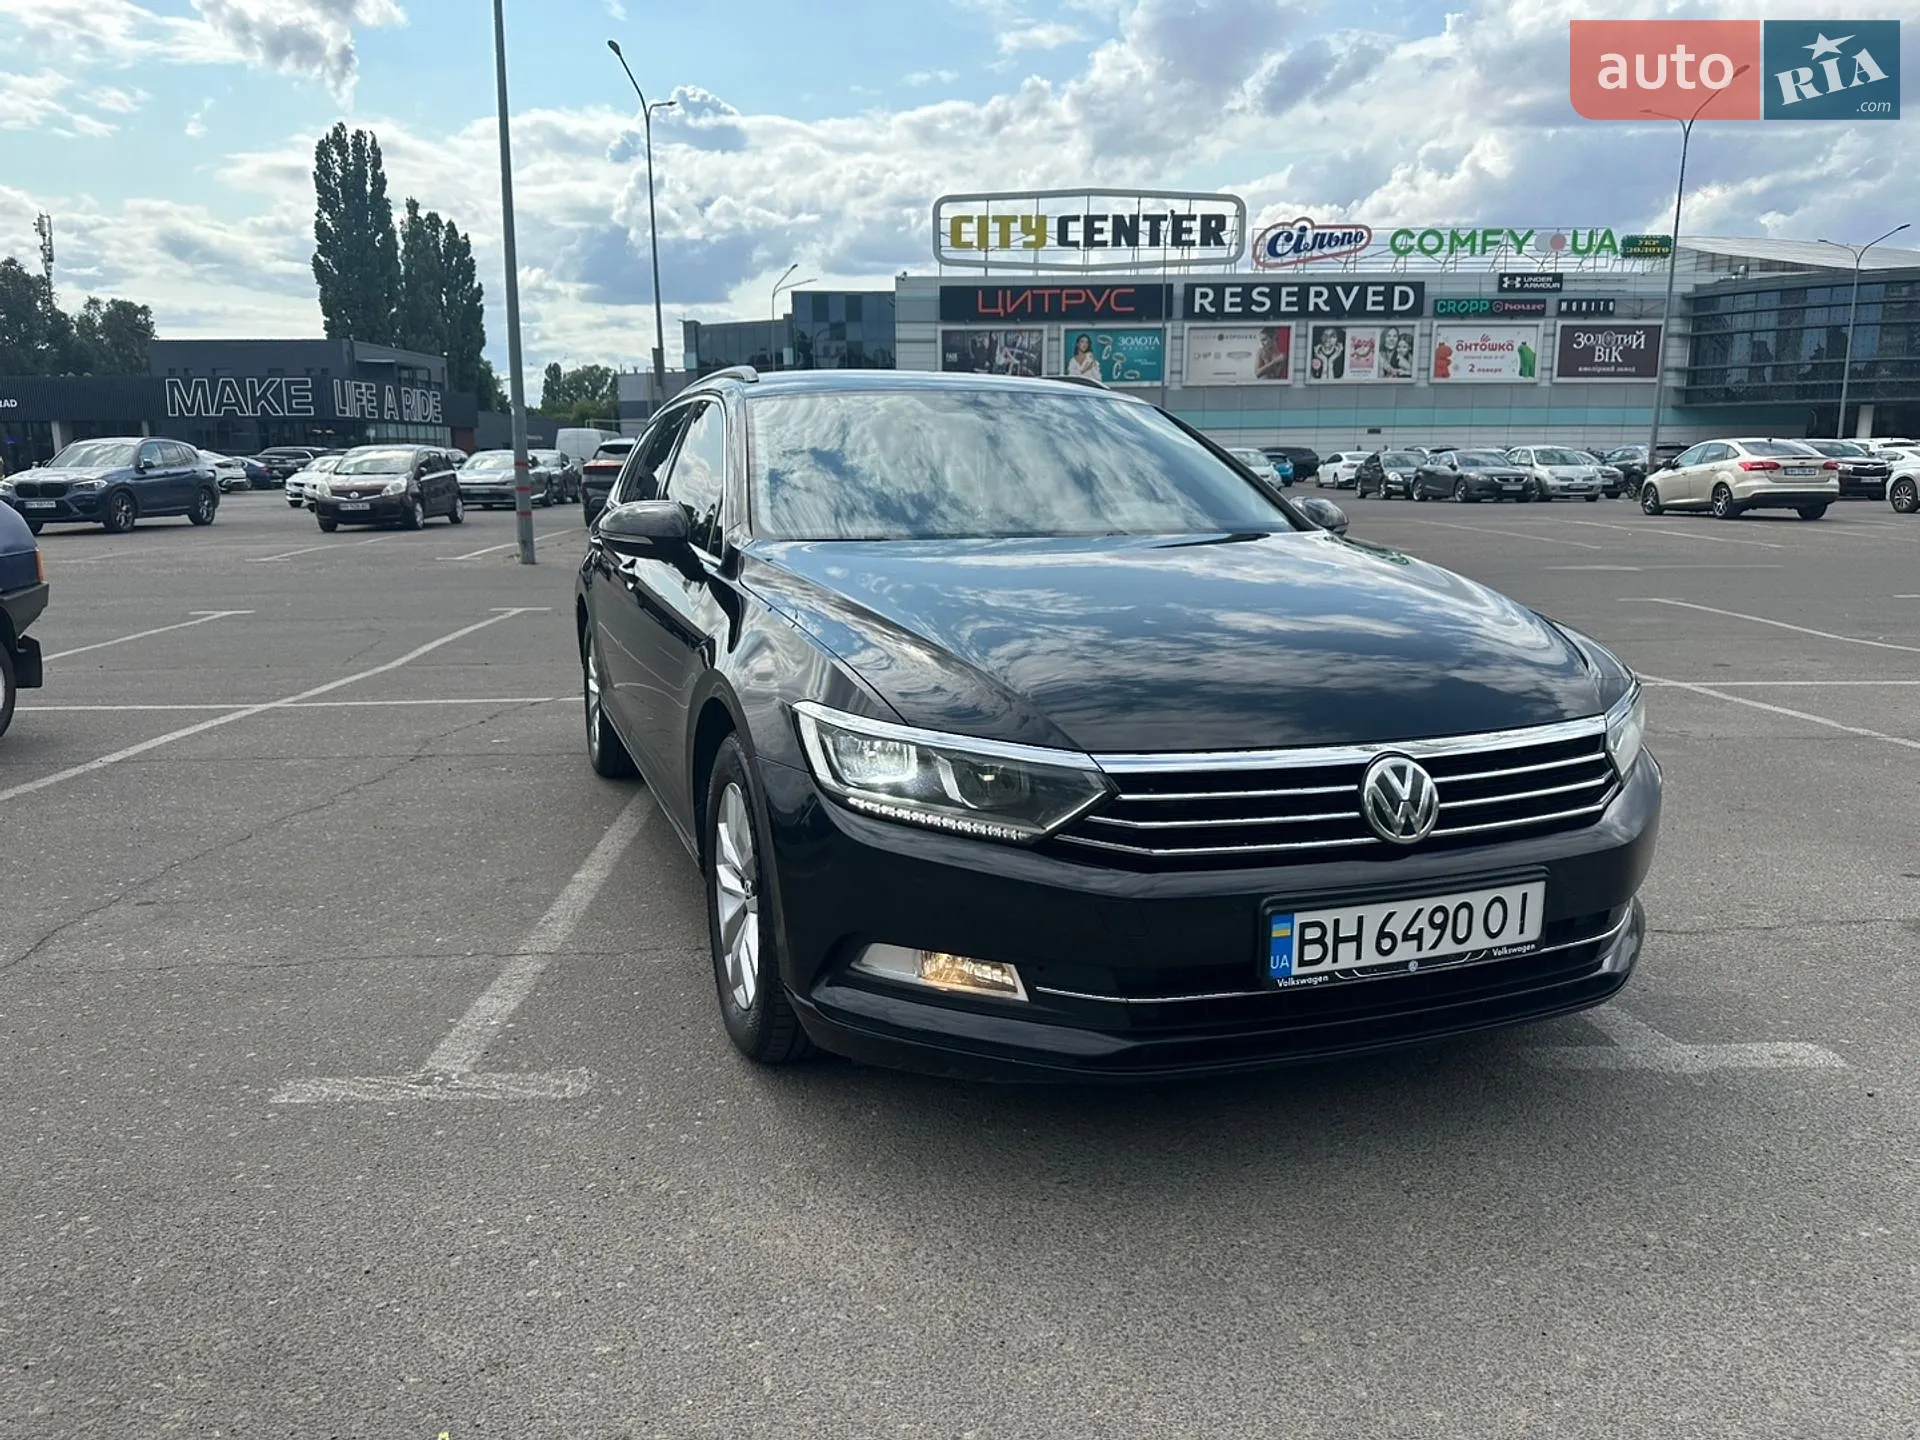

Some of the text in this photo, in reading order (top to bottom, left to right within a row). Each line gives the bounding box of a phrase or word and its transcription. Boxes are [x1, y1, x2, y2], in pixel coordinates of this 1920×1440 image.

[950, 213, 1227, 249] CITY CENTER
[1267, 225, 1366, 258] Сільпо
[1389, 227, 1619, 256] COMFY UA
[977, 288, 1136, 317] ЦИТРУС
[1193, 285, 1416, 313] RESERVED
[1437, 300, 1490, 313] CROPP
[1468, 363, 1475, 373] 2
[165, 377, 443, 424] MAKE LIFE A RIDE
[1297, 892, 1528, 968] BH 6490 OI
[1270, 953, 1290, 969] UA
[1492, 943, 1536, 957] Volkswagen
[1277, 974, 1329, 988] Volkswagen
